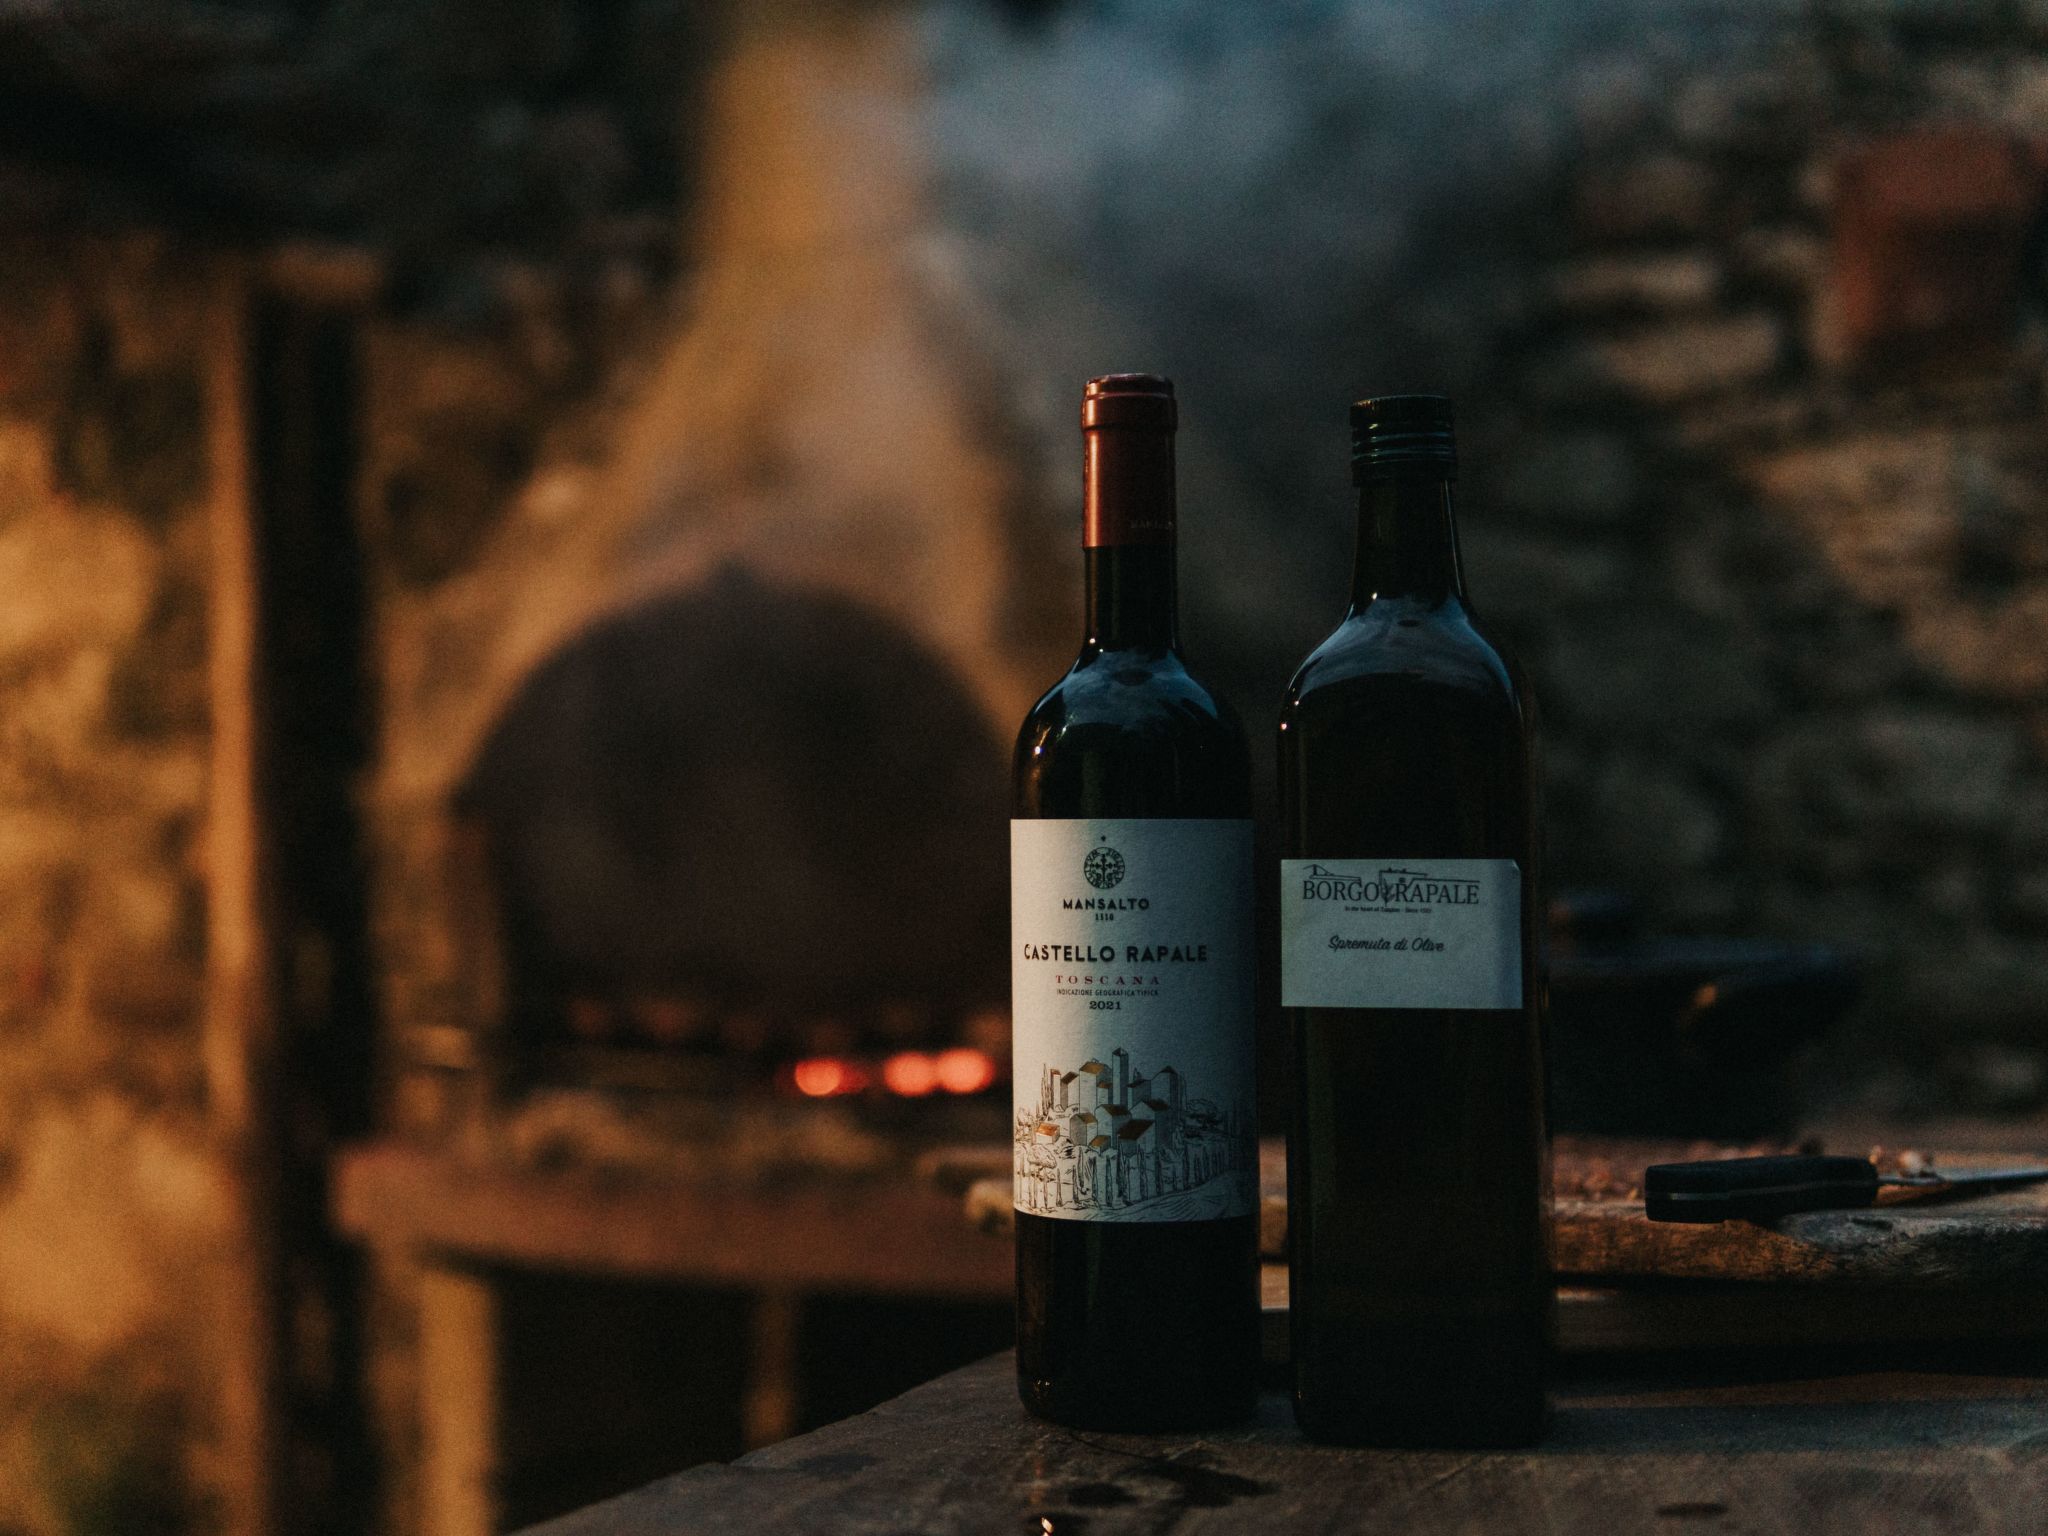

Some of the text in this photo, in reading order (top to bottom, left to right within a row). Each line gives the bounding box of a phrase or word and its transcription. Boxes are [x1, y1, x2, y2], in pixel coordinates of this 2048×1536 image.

[1303, 880, 1480, 904] BORGO RAPALE
[1063, 898, 1150, 910] MANSALTO
[1328, 934, 1445, 952] Spremuta di Olive
[1024, 943, 1208, 962] CASTELLO RAPALE
[1056, 975, 1160, 985] TOSCANA
[1057, 988, 1093, 996] INDICAZIONE
[1095, 989, 1135, 997] GEOGRAFICA
[1089, 1000, 1121, 1010] 2021
